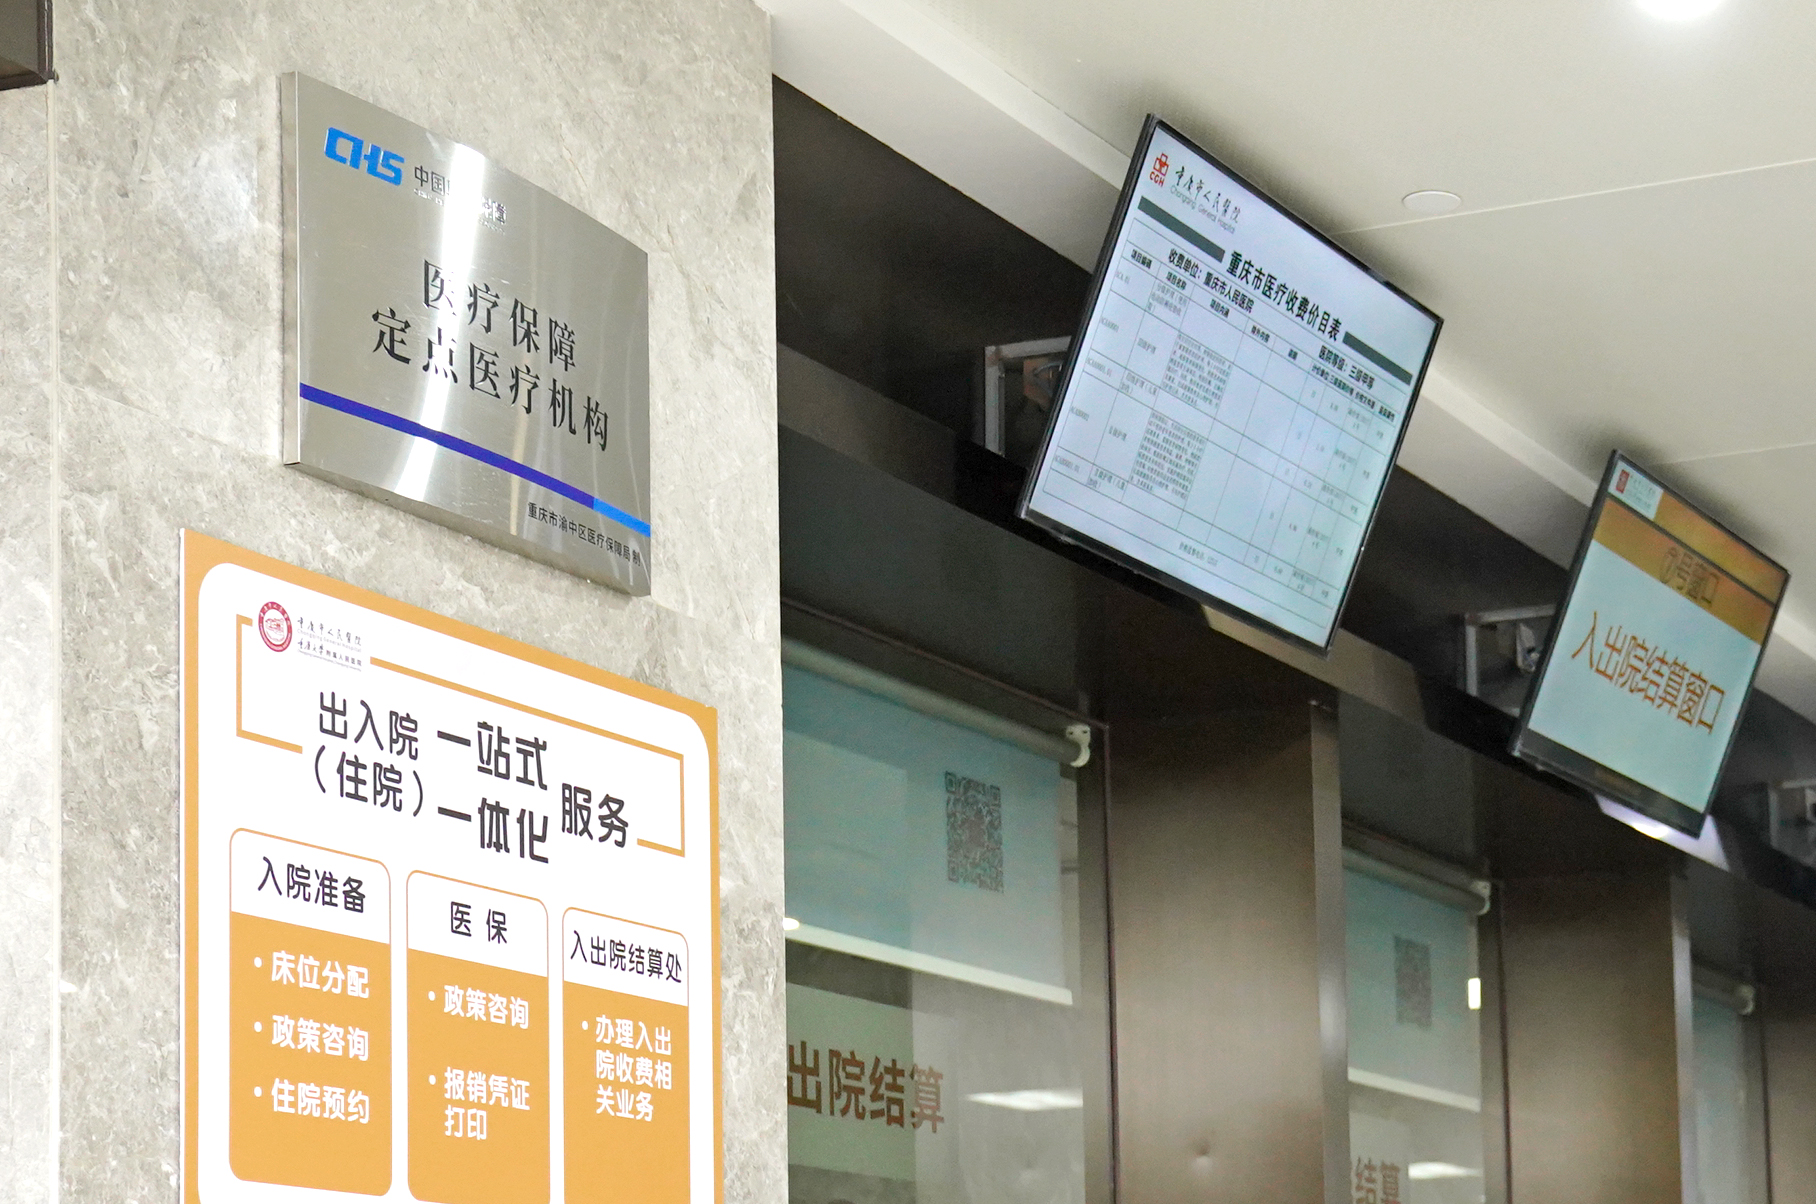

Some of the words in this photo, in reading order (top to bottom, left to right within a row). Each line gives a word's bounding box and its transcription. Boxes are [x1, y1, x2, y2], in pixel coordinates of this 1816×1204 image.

[324, 127, 405, 186] CHS
[1149, 171, 1165, 188] CGH
[423, 258, 577, 373] 医疗保障
[1226, 250, 1342, 341] 重庆市医疗收费价目表
[371, 306, 609, 452] 定点医疗机构
[1571, 611, 1725, 735] 入出院结算窗口
[319, 692, 418, 761] 出入院
[437, 721, 548, 791] 一站式
[561, 783, 629, 848] 服务
[437, 798, 550, 864] 一体化
[257, 856, 367, 914] 入院准备
[271, 950, 370, 999] 床位分配
[570, 930, 682, 984] 入出院结算处
[443, 985, 529, 1030] 政策咨询
[271, 1014, 370, 1062] 政策咨询
[595, 1016, 672, 1056] 办理入出
[444, 1066, 530, 1111] 报销凭证
[595, 1049, 672, 1090] 院收费相
[271, 1078, 370, 1125] 住院预约
[444, 1107, 488, 1141] 打印
[595, 1085, 654, 1122] 关业务
